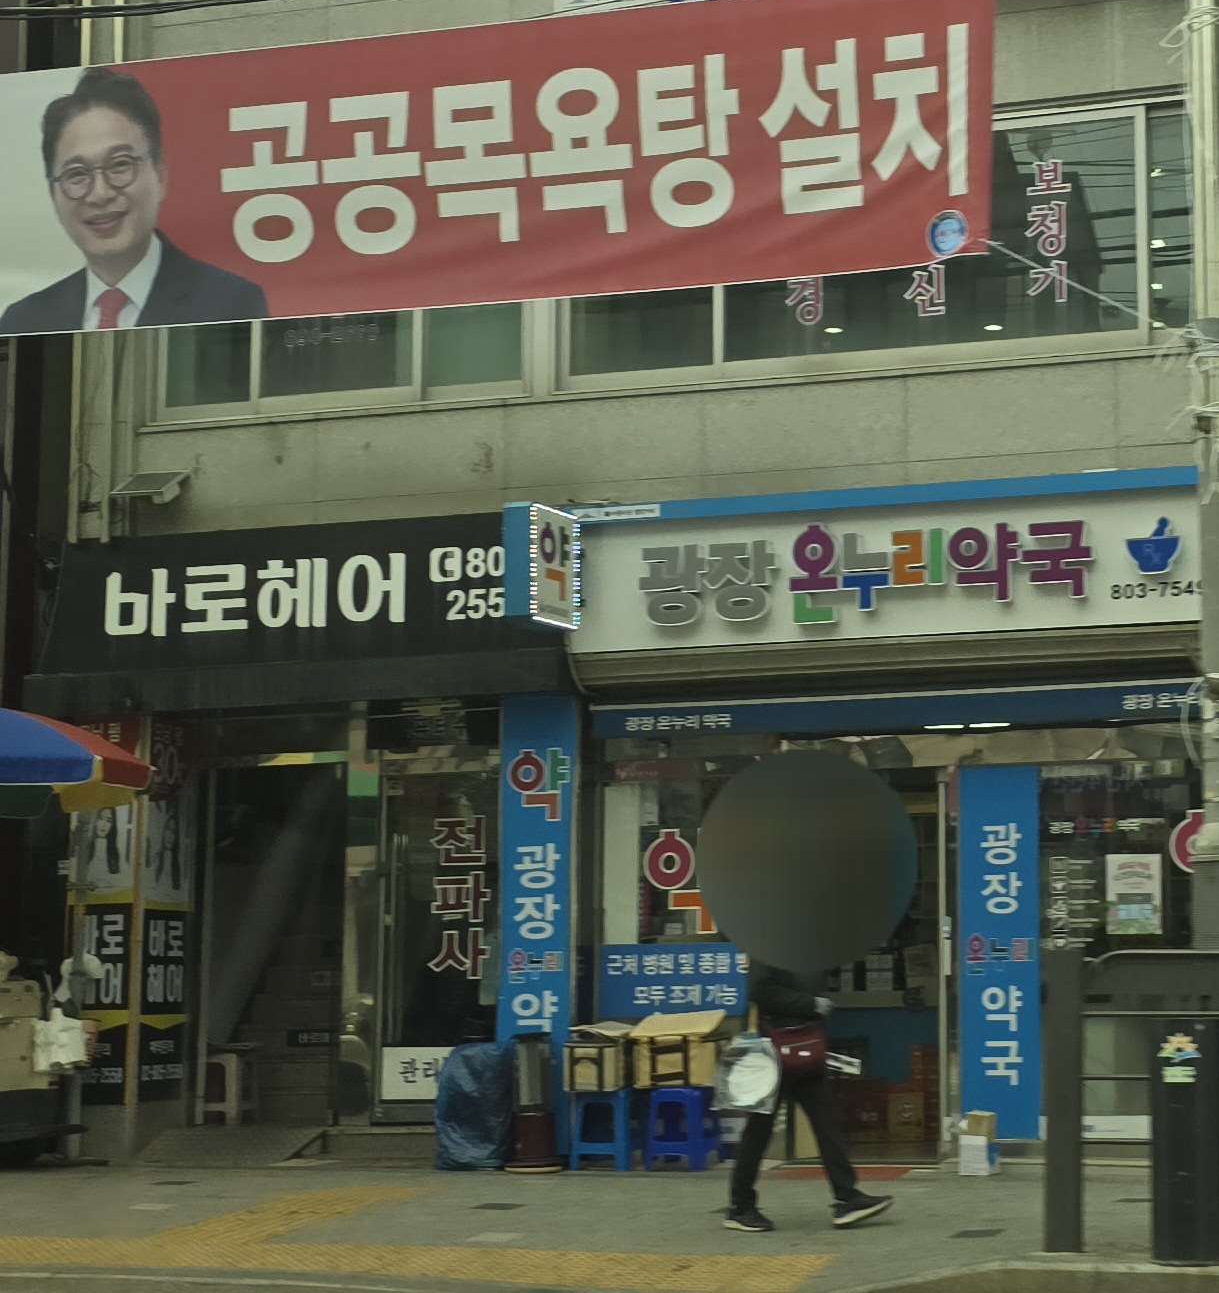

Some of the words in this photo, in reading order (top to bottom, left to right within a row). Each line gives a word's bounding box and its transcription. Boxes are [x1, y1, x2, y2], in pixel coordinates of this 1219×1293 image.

[221, 53, 740, 262] 공공목욕탕
[758, 22, 971, 215] 설치
[1024, 159, 1071, 303] 보청기
[104, 552, 407, 637] 바로헤어
[540, 521, 571, 602] 약
[639, 539, 777, 627] 광장
[507, 747, 571, 822] 약
[428, 814, 492, 980] 전파사
[514, 842, 561, 940] 광장
[980, 822, 1023, 915] 광장
[633, 985, 667, 1006] 모두
[705, 983, 739, 1005] 가능
[980, 985, 1024, 1086] 약국
